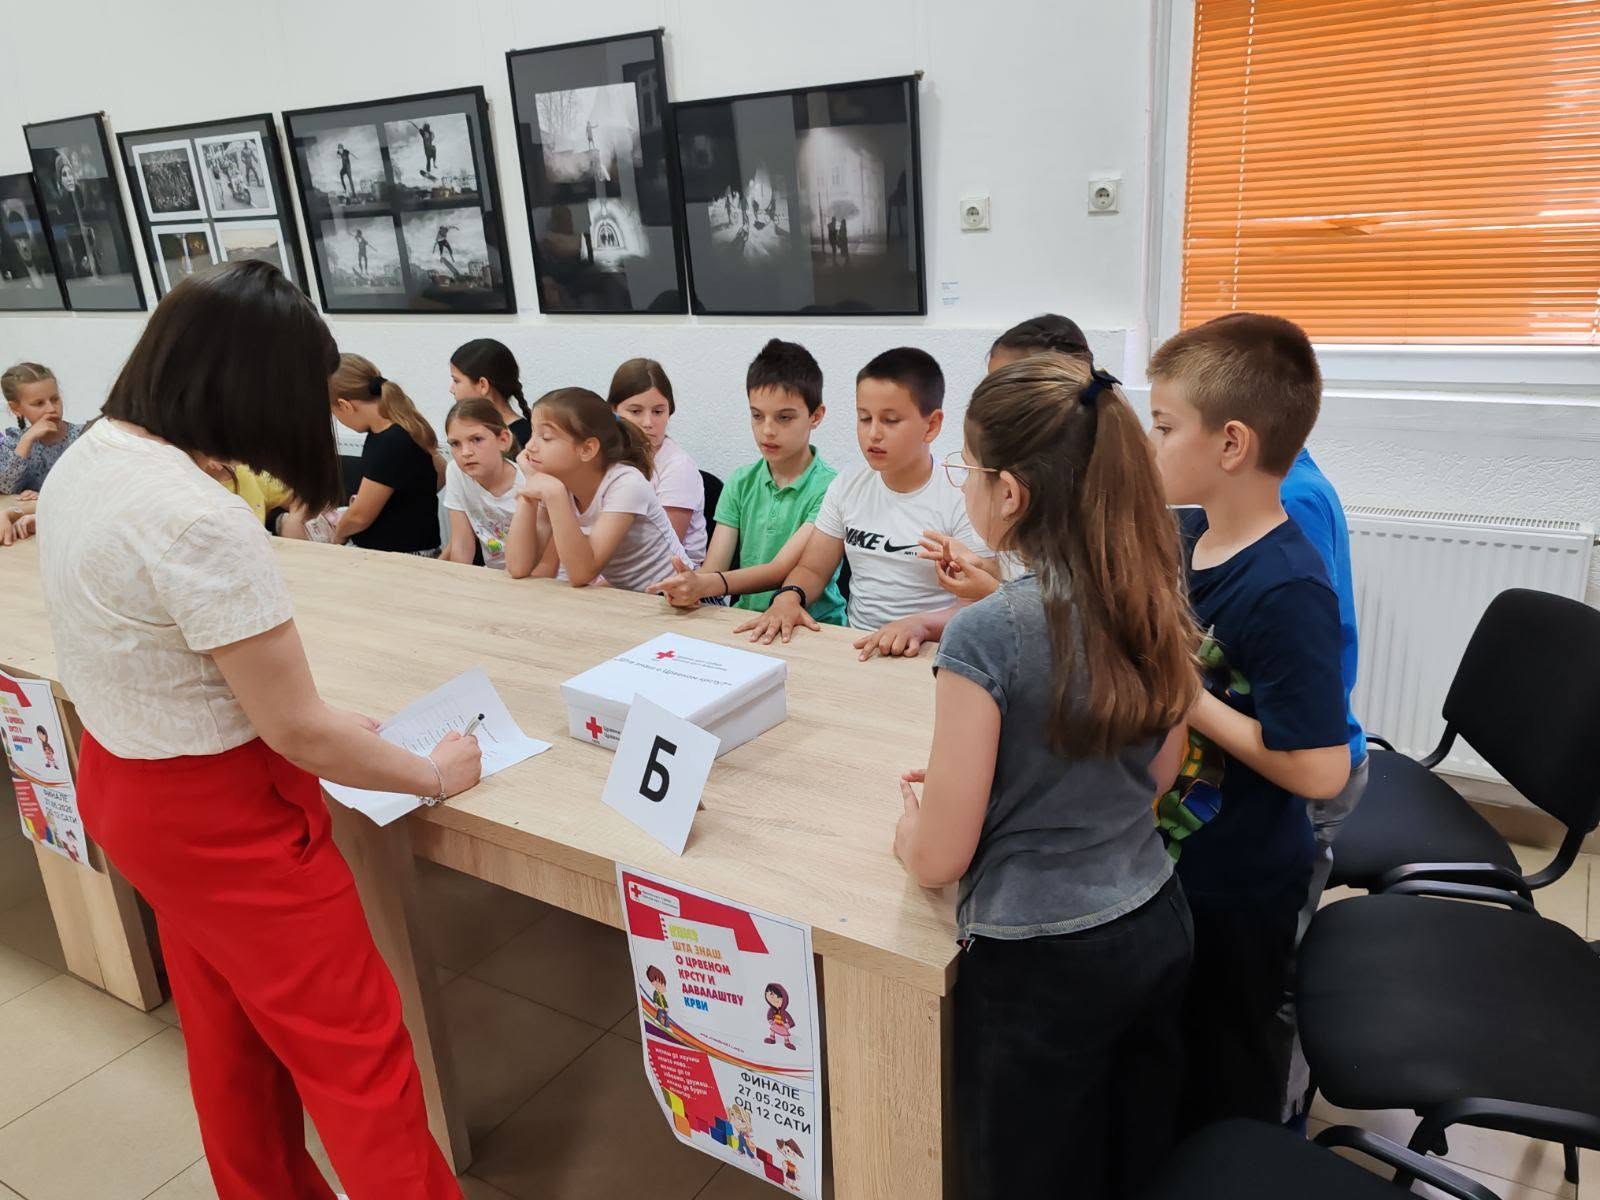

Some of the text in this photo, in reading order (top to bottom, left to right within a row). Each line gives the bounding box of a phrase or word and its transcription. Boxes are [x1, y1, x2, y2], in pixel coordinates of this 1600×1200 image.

[845, 526, 884, 550] NIKE
[639, 735, 677, 802] Б
[672, 941, 721, 959] ШТА ЗНАШ
[675, 954, 731, 975] О ЦРВЕНОМ
[678, 969, 716, 985] КРСТУ И
[682, 983, 744, 1006] ДАВАЛАШТВУ
[684, 997, 709, 1012] КРВИ
[741, 1072, 800, 1101] ФИНАЛЕ
[738, 1084, 806, 1117] 27.05.2026
[735, 1096, 812, 1135] ОД 12 САТИ
